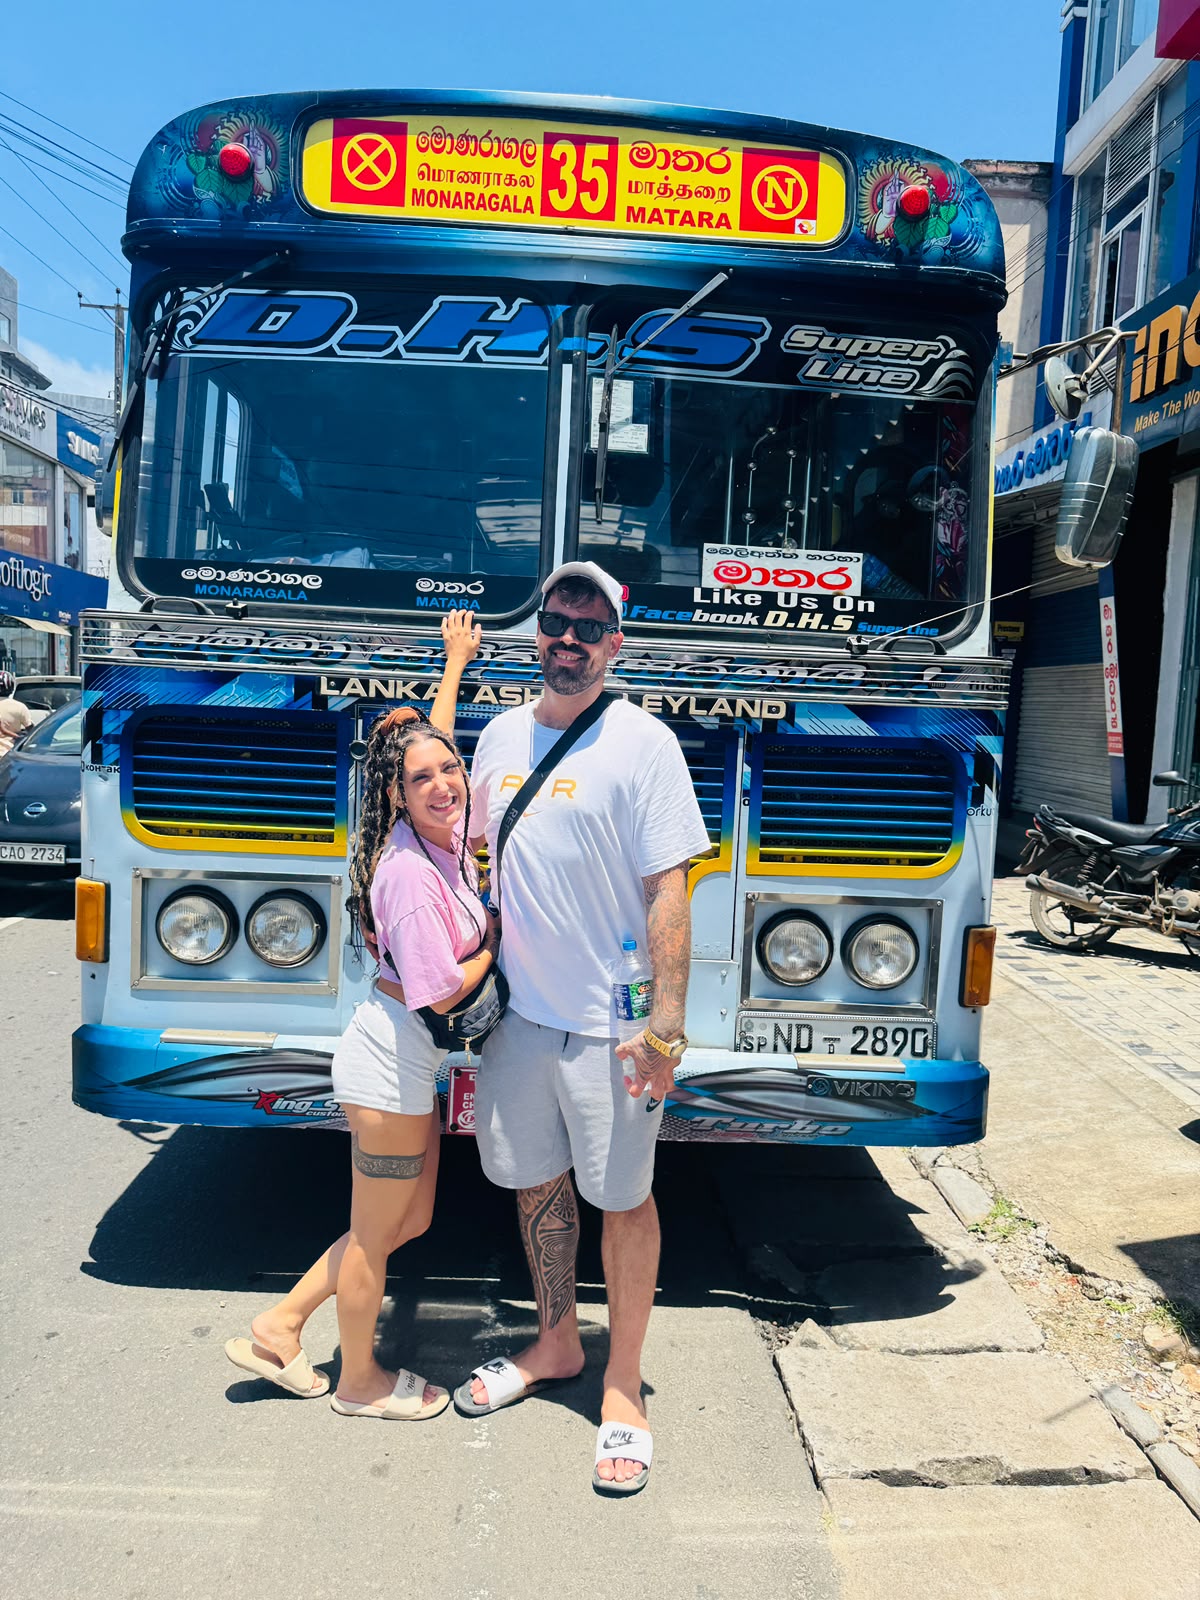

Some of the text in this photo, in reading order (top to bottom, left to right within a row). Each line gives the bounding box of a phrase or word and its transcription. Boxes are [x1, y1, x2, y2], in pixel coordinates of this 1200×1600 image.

[416, 125, 537, 168] මොණරාගල
[628, 140, 732, 175] මාතර
[416, 161, 535, 190] மொணராகல
[547, 139, 610, 214] 35
[627, 175, 732, 205] மாத்தறை
[411, 188, 535, 214] MONARAGALA
[625, 205, 733, 230] MATARA
[784, 327, 943, 362] Super
[803, 357, 918, 389] Line
[1133, 410, 1160, 434] Make
[1162, 399, 1182, 420] The
[0, 556, 53, 602] oftlogic
[415, 577, 485, 595] මාතර
[713, 559, 853, 590] මාතර
[194, 584, 308, 602] MONARAGALA
[416, 596, 481, 610] MATARA
[693, 587, 876, 613] Like Us On
[629, 605, 940, 637] Facebook D.H.S Super Line
[320, 676, 788, 720] LANKA ASH EYLAND
[499, 774, 578, 800] AR
[31, 847, 64, 862] 2734
[742, 1022, 931, 1058] SP ND 2890
[689, 1115, 855, 1137] Turbo
[609, 1429, 635, 1442] NIKE
